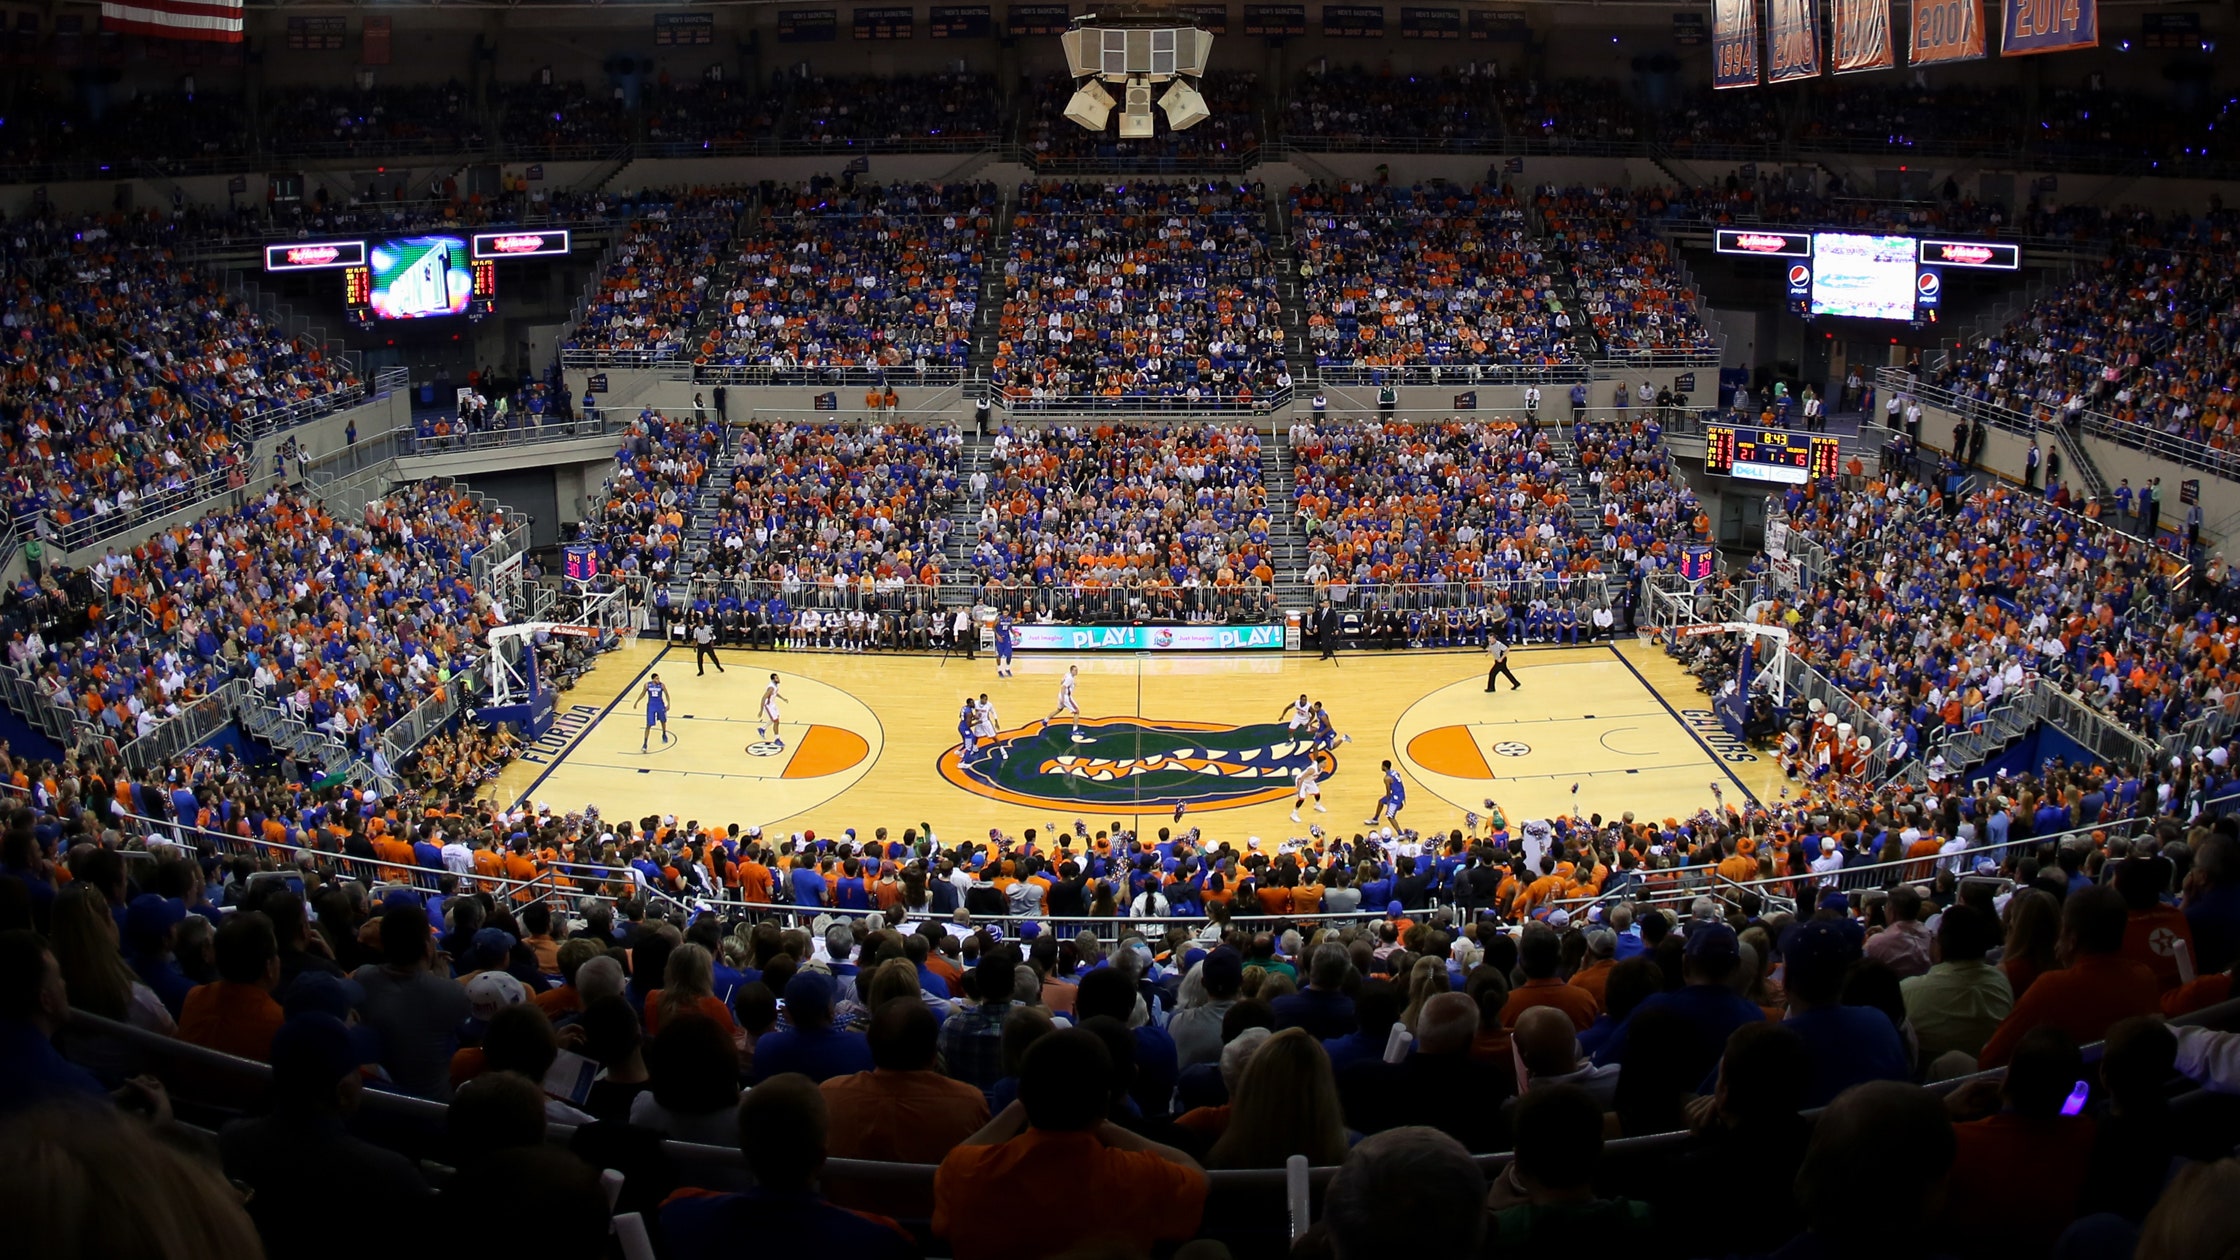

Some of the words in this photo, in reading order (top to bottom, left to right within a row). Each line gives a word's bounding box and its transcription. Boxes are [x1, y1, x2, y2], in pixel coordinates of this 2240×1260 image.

[2015, 0, 2081, 38] 2014
[1717, 41, 1752, 79] 1994
[1764, 432, 1788, 446] 8:43
[1740, 448, 1755, 461] 21
[1794, 455, 1806, 466] 15
[1736, 466, 1765, 478] DELL
[567, 561, 581, 578] 30
[1698, 560, 1711, 578] 30
[1073, 626, 1136, 649] PLAY!
[1219, 626, 1282, 649] PLAY!
[517, 704, 602, 765] FLORIDA
[1680, 709, 1758, 763] GATORS
